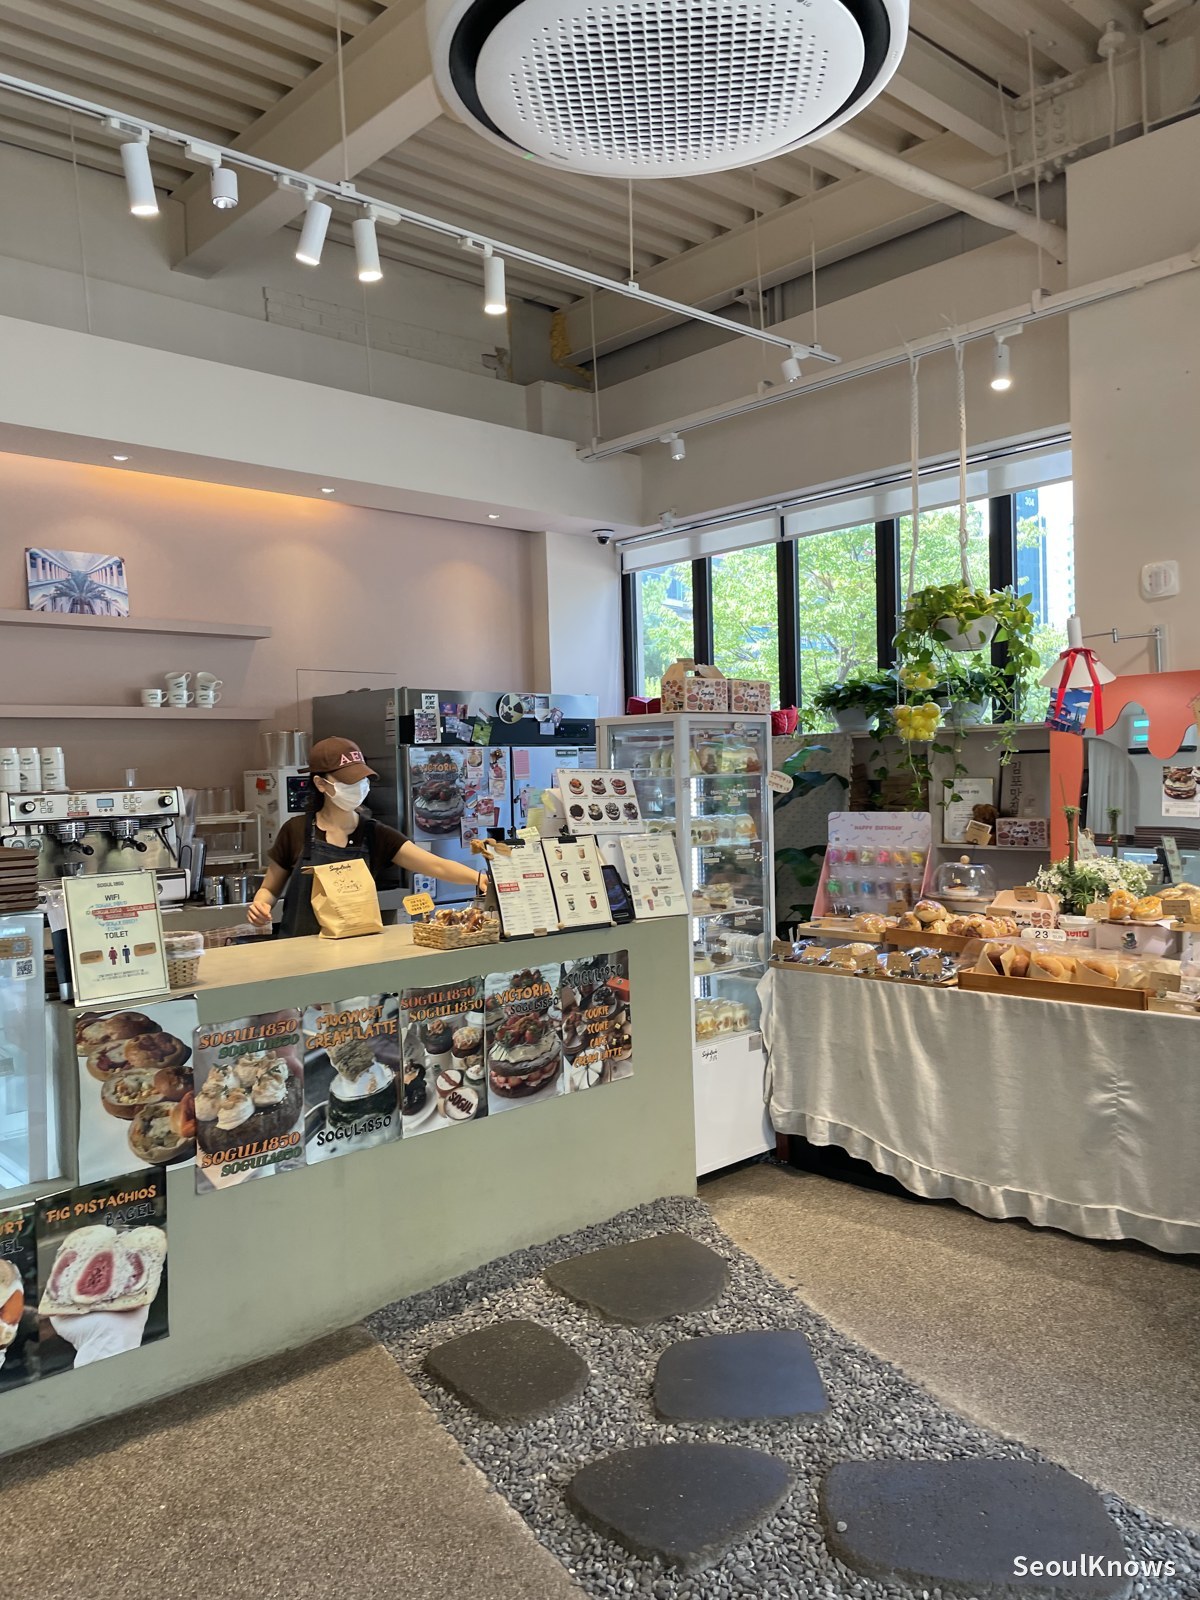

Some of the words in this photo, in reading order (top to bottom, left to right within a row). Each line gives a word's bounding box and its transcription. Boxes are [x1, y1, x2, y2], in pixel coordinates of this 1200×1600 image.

[420, 763, 458, 772] VICTORIA
[1010, 760, 1022, 815] 김포맛집
[104, 930, 128, 939] TOILET
[1035, 930, 1048, 938] 23
[400, 986, 476, 1010] SOGUL1850
[496, 982, 552, 1006] VICTORIA
[316, 1005, 384, 1030] MUGWORT
[409, 999, 484, 1022] SOGUL1850
[584, 1005, 610, 1020] COOKIE
[199, 1019, 297, 1050] SOGUL1850
[305, 1027, 354, 1050] CREAM
[356, 1020, 398, 1040] LATTE
[587, 1020, 609, 1034] SCONE
[218, 1034, 300, 1059] SOGUL1850
[572, 1052, 598, 1068] CREAM
[600, 1046, 622, 1060] LATTE
[448, 1092, 474, 1114] SOGUL
[317, 1116, 392, 1146] SOGUL1850
[201, 1132, 300, 1169] SOGUL1850
[220, 1146, 300, 1177] SOGUL1850
[46, 1208, 70, 1224] FIG
[74, 1184, 157, 1217] PISTACHIOS
[105, 1202, 156, 1226] BAGEL
